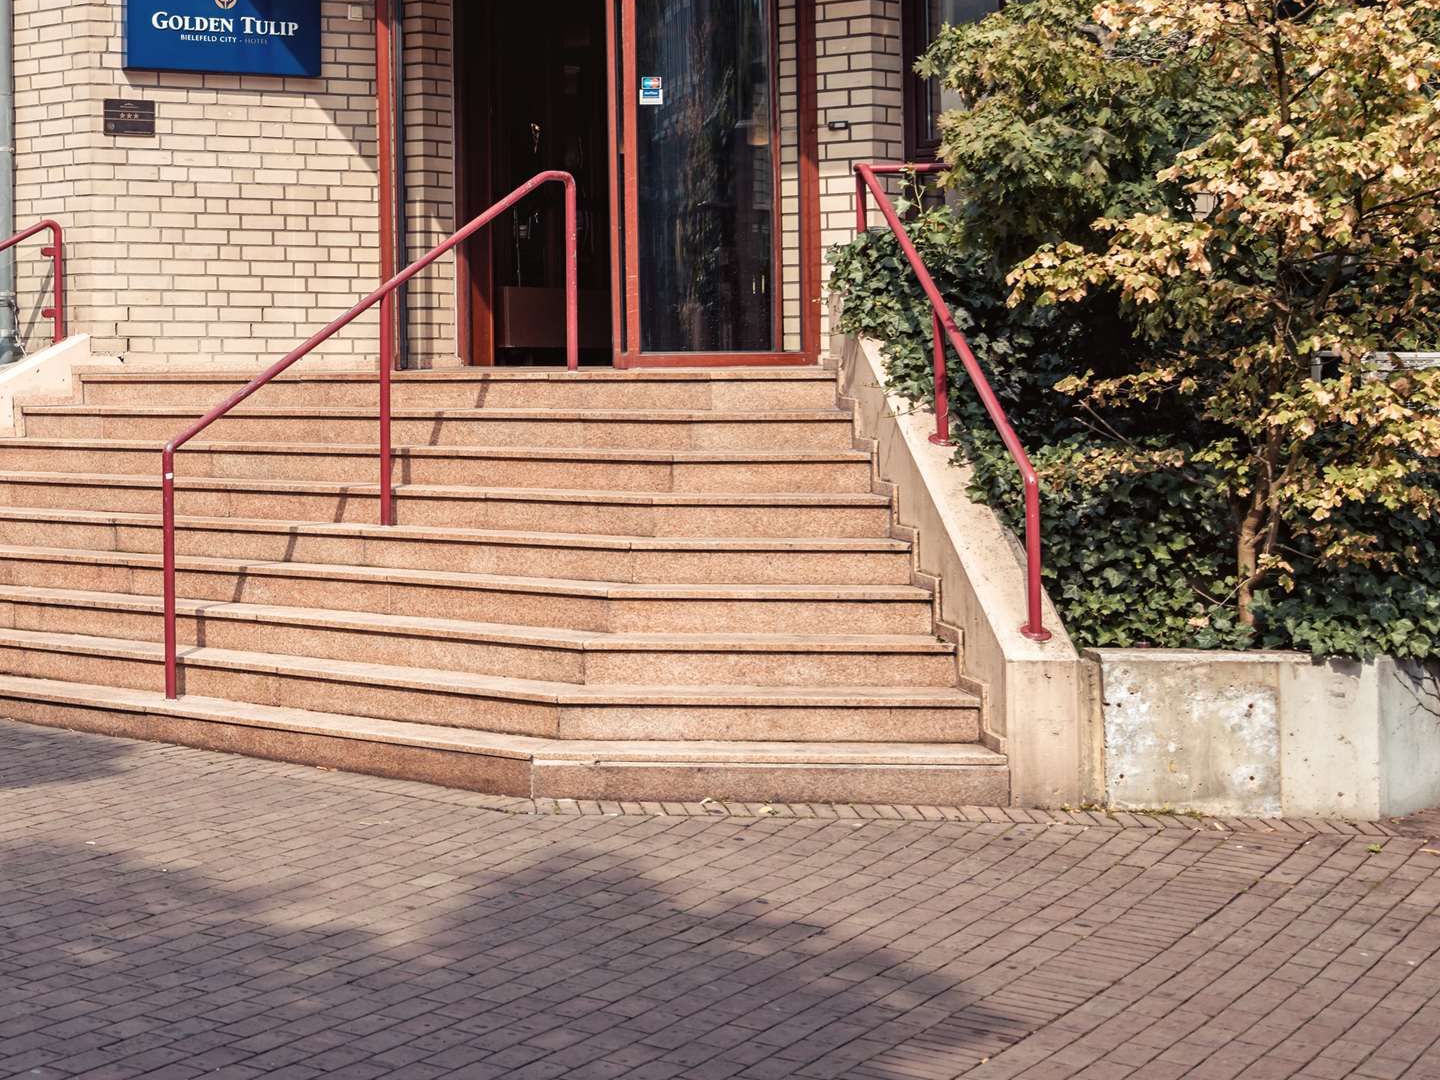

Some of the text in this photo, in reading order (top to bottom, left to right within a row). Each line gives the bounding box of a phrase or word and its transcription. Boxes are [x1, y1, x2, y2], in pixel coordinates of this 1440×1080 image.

[151, 11, 300, 37] GOLDEN TULIP
[180, 34, 218, 43] BIELEFELD
[219, 36, 237, 44] CITY
